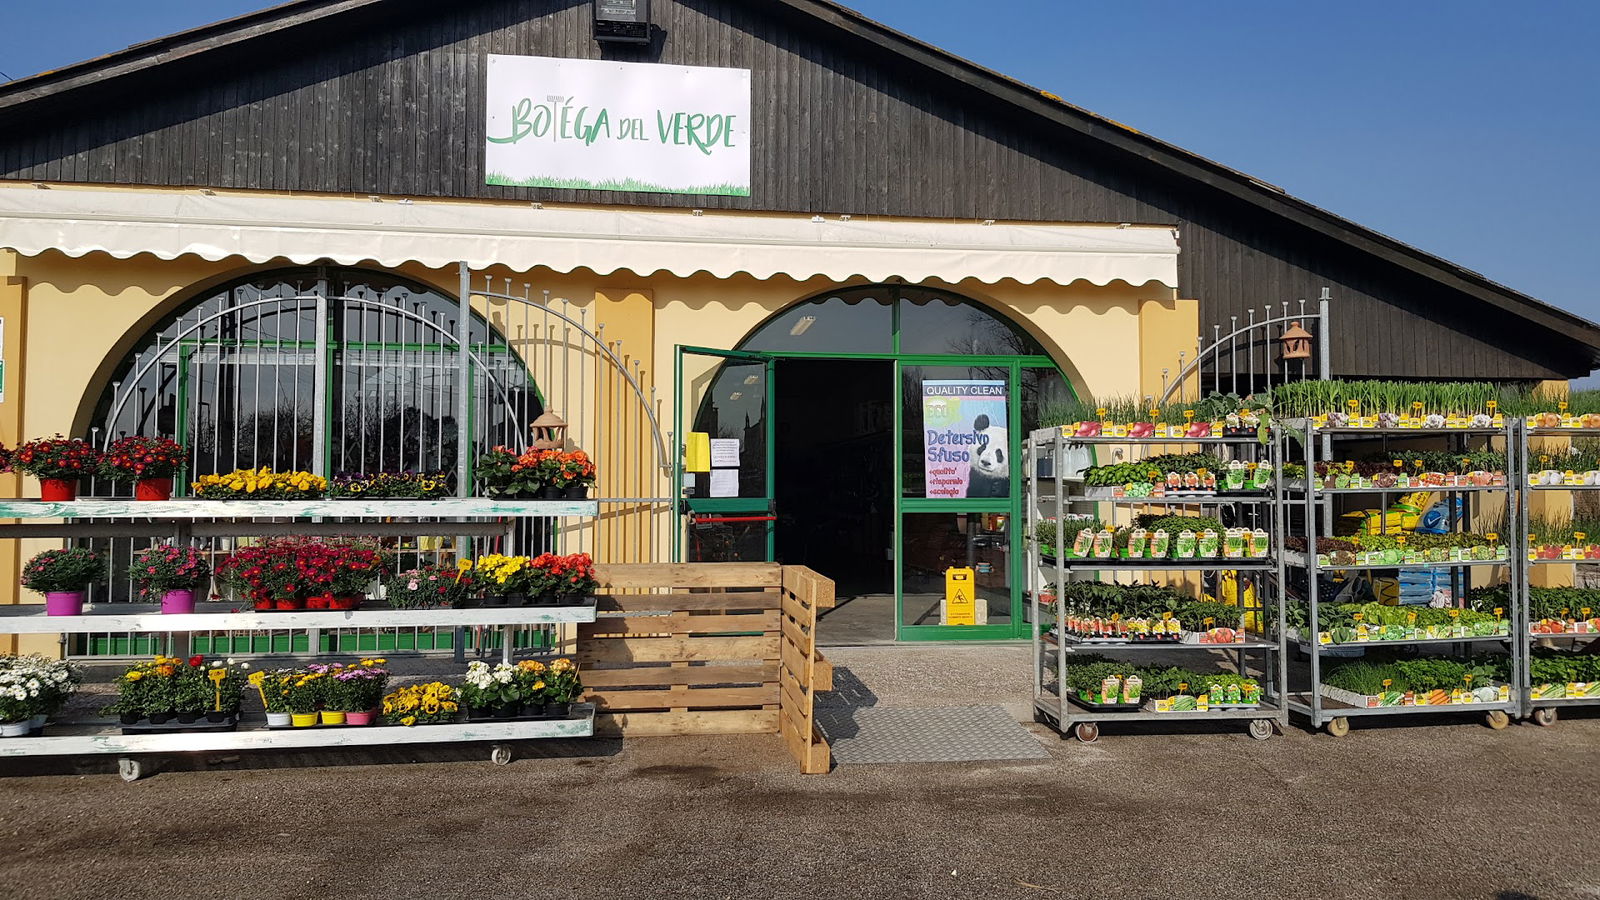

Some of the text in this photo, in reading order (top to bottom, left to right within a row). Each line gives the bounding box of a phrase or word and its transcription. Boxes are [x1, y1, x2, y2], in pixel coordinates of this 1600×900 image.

[617, 118, 649, 141] DEL
[657, 109, 736, 155] VERDE
[926, 386, 1003, 395] QUALITY CLEAN
[926, 429, 990, 446] Detersivo
[927, 446, 970, 462] Sfuso
